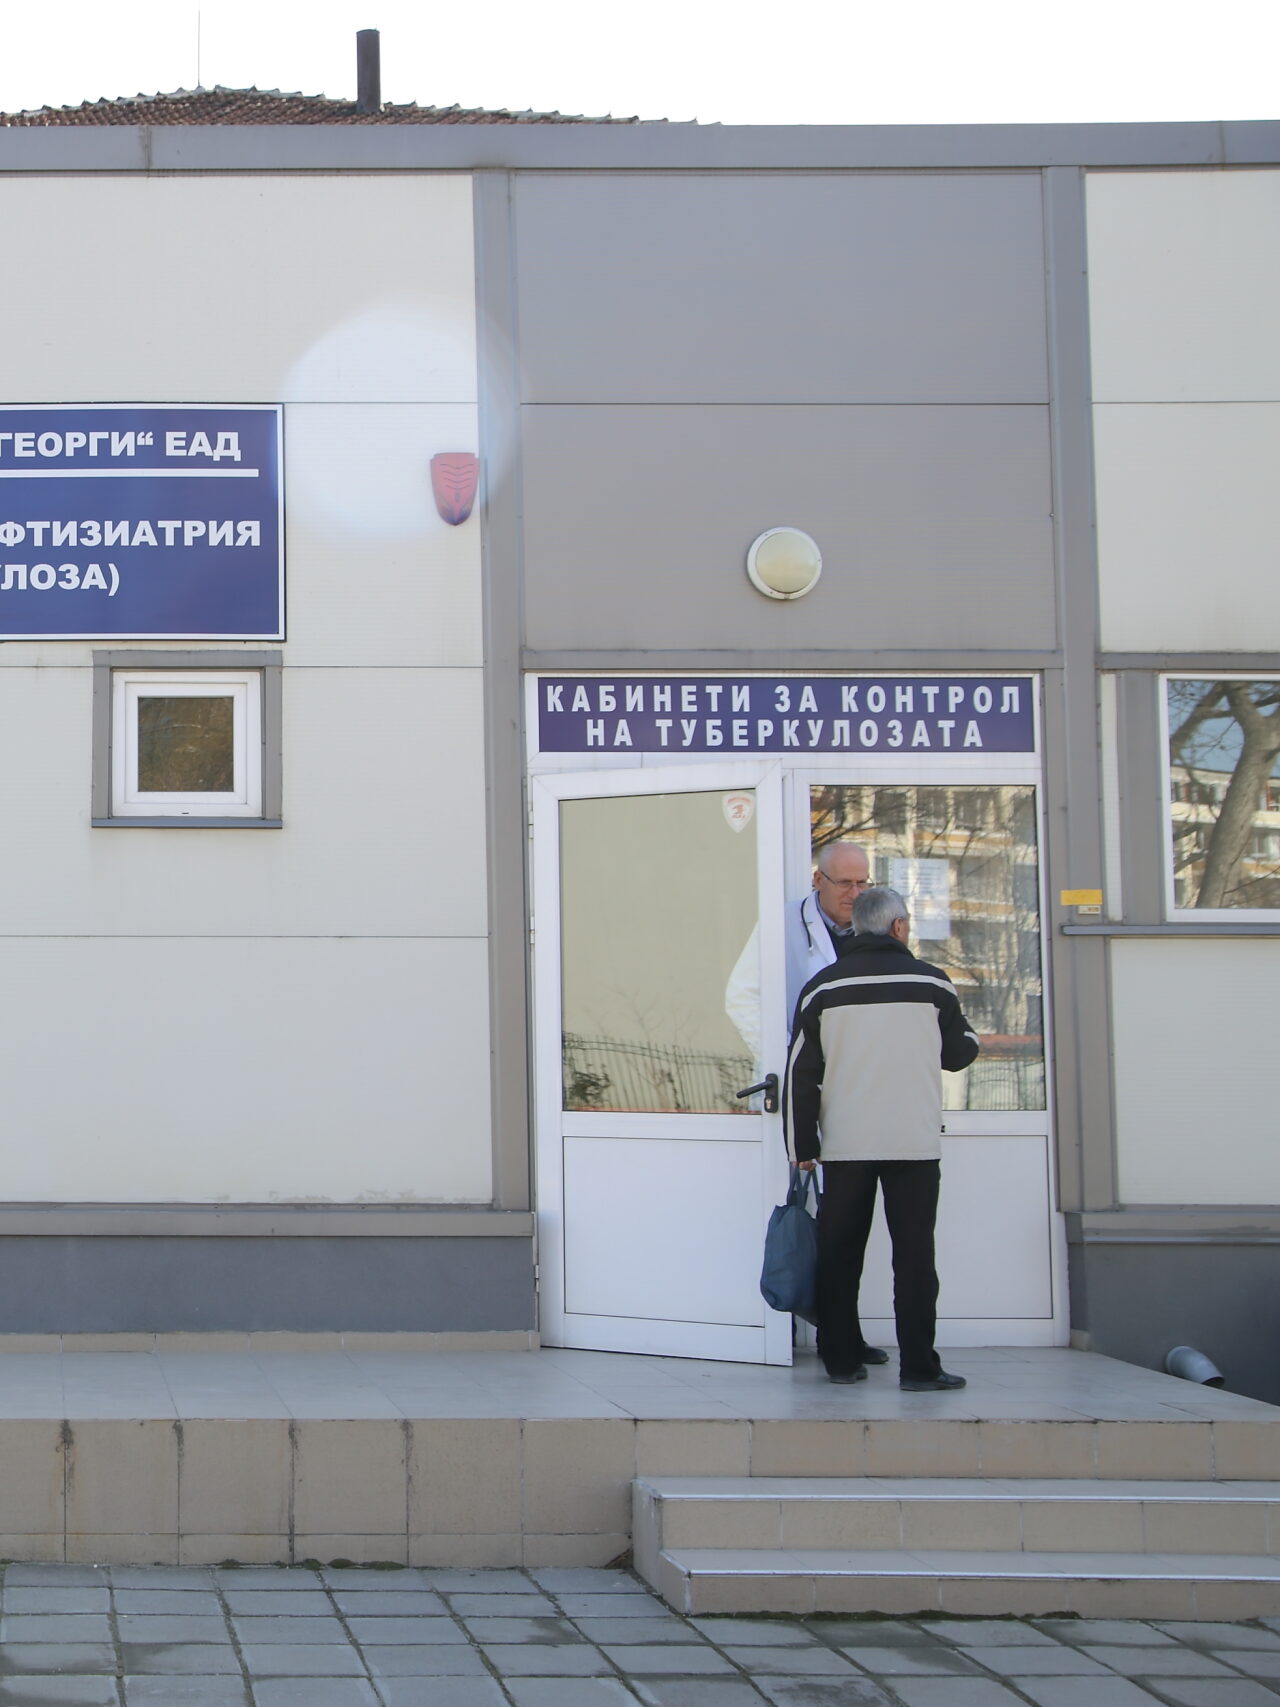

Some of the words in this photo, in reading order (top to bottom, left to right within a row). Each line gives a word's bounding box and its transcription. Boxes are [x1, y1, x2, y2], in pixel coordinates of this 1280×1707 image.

[165, 431, 242, 461] ЕАД
[547, 685, 750, 712] КАБИНЕТИ
[774, 685, 818, 713] ЗА
[841, 685, 1020, 714] КОНТРОЛ
[586, 718, 633, 746] НА
[655, 718, 983, 748] ТУБЕРКУЛОЗАТА
